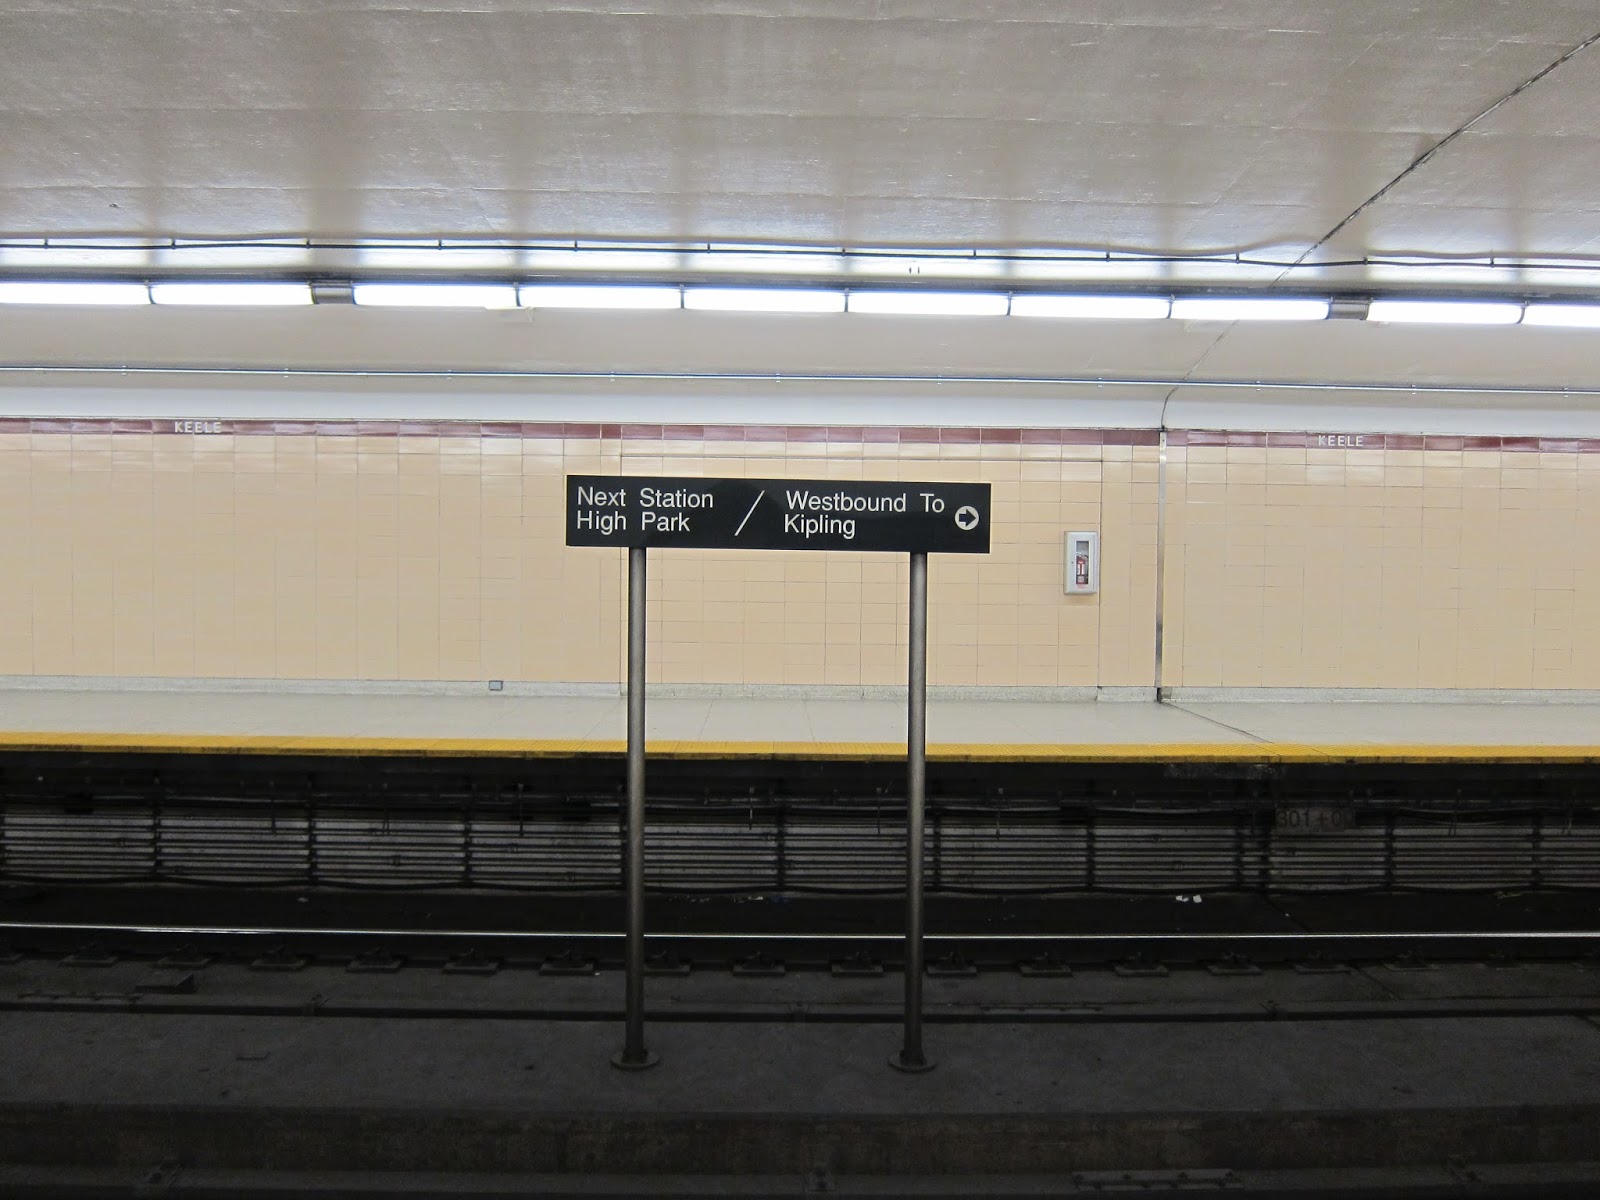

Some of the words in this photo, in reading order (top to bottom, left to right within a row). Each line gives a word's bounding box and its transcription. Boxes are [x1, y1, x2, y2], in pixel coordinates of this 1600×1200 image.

[174, 421, 222, 433] KEELE
[1318, 435, 1364, 447] KEELE
[577, 486, 627, 507] Next
[639, 487, 714, 508] Station
[785, 490, 907, 512] Westbound
[919, 493, 945, 513] To
[576, 510, 627, 535] High
[641, 511, 691, 532] Park
[784, 513, 856, 540] Kipling
